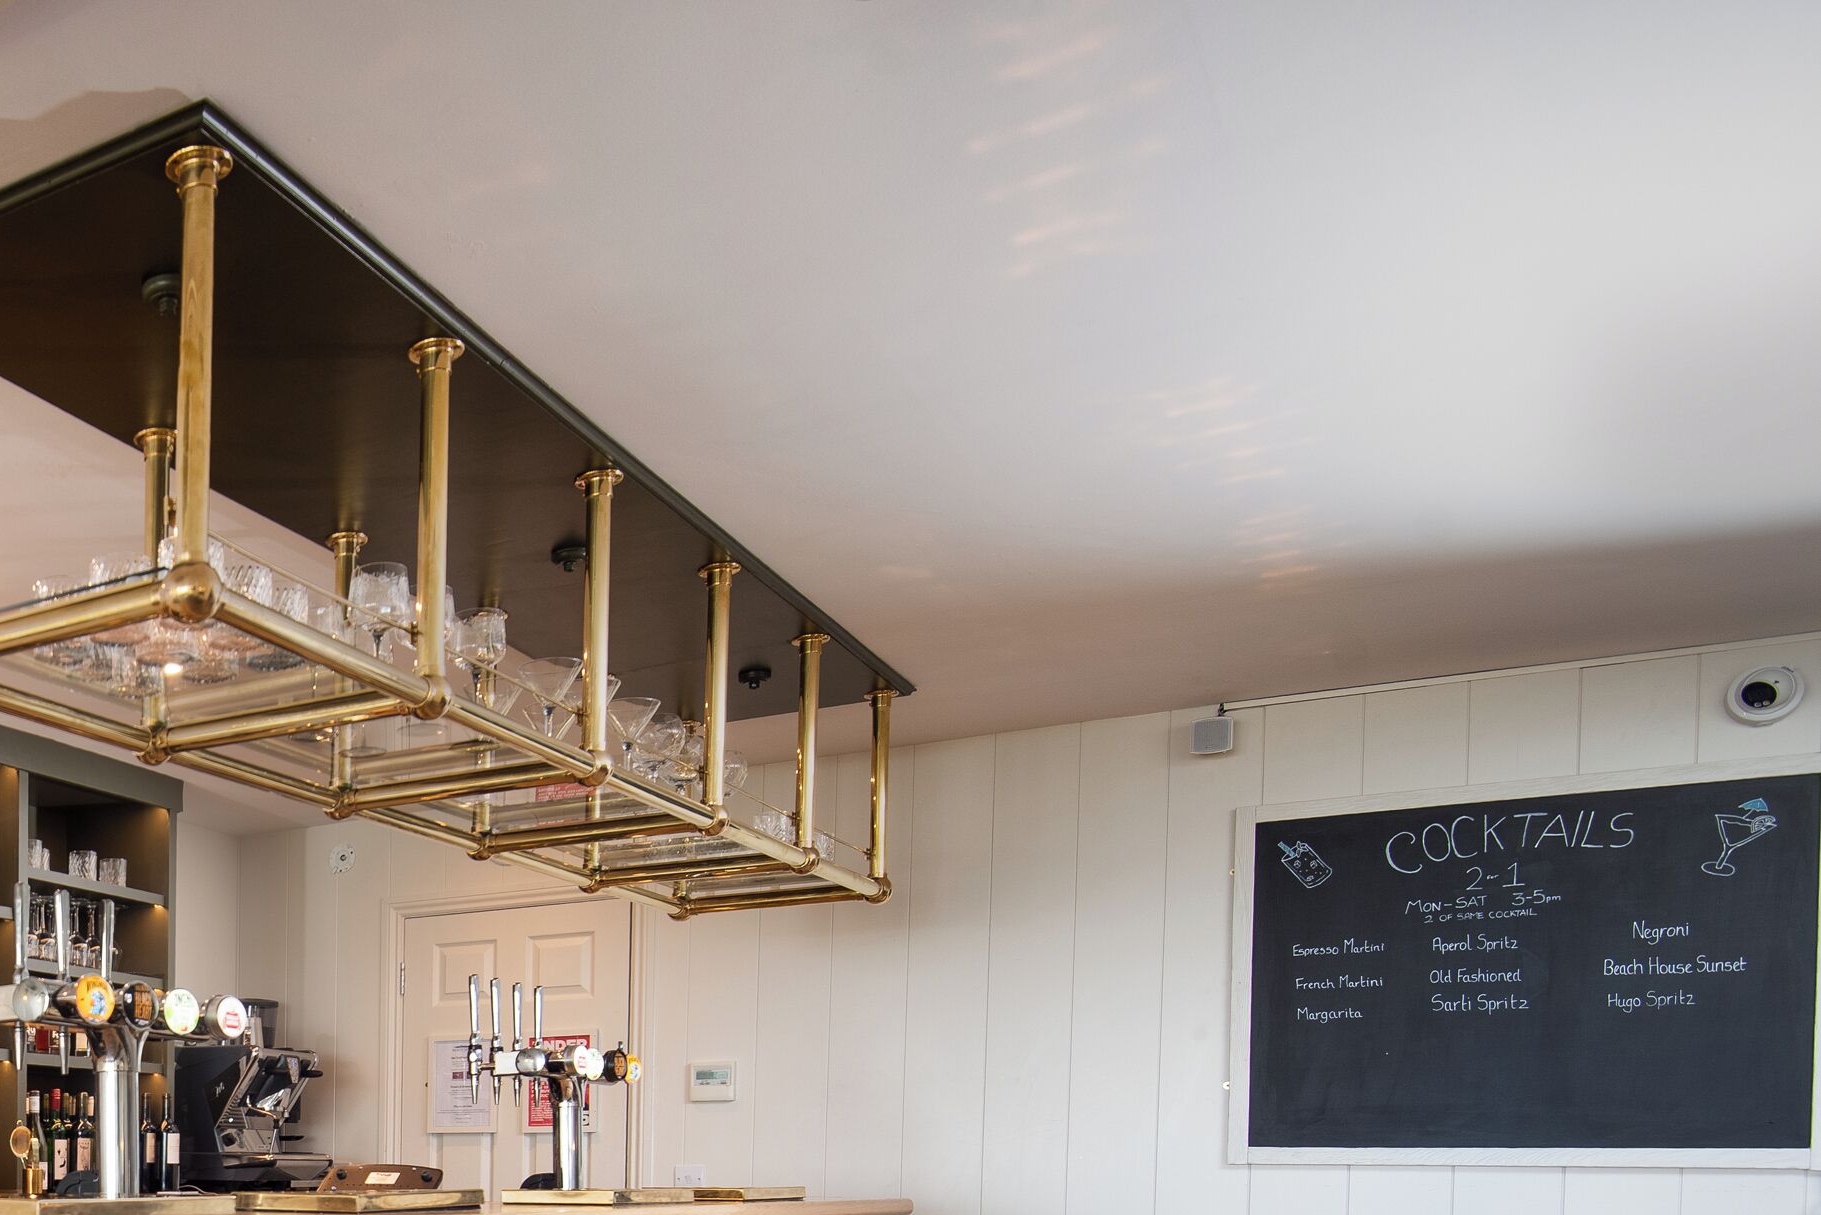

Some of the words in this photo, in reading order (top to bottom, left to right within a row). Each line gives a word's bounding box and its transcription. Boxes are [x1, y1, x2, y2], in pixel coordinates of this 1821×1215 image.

[1385, 810, 1635, 874] COCKTAILS
[1466, 866, 1483, 891] 2
[1502, 862, 1525, 888] 1
[1511, 889, 1562, 906] 3-5pm
[1423, 914, 1434, 923] 2
[1439, 913, 1453, 922] OF
[1456, 911, 1484, 921] SAME
[1488, 907, 1538, 919] COCKTAIL
[1432, 934, 1472, 955] Aperol
[1476, 933, 1519, 953] Spritz
[1632, 920, 1689, 946] Negroni
[1292, 943, 1339, 957] Espresso
[1343, 937, 1385, 954] Martini
[1429, 969, 1452, 984] Old
[1457, 968, 1522, 983] Fashioned
[1603, 958, 1644, 976] Beach
[1648, 956, 1693, 975] House
[1696, 954, 1748, 973] Sunset
[1295, 977, 1335, 990] French
[1339, 974, 1383, 989] Martini
[1431, 993, 1472, 1012] Sarti
[1476, 993, 1529, 1015] Spritz
[1607, 993, 1641, 1013] Hugo
[1645, 989, 1696, 1010] Spritz
[1297, 1007, 1363, 1024] Margarita
